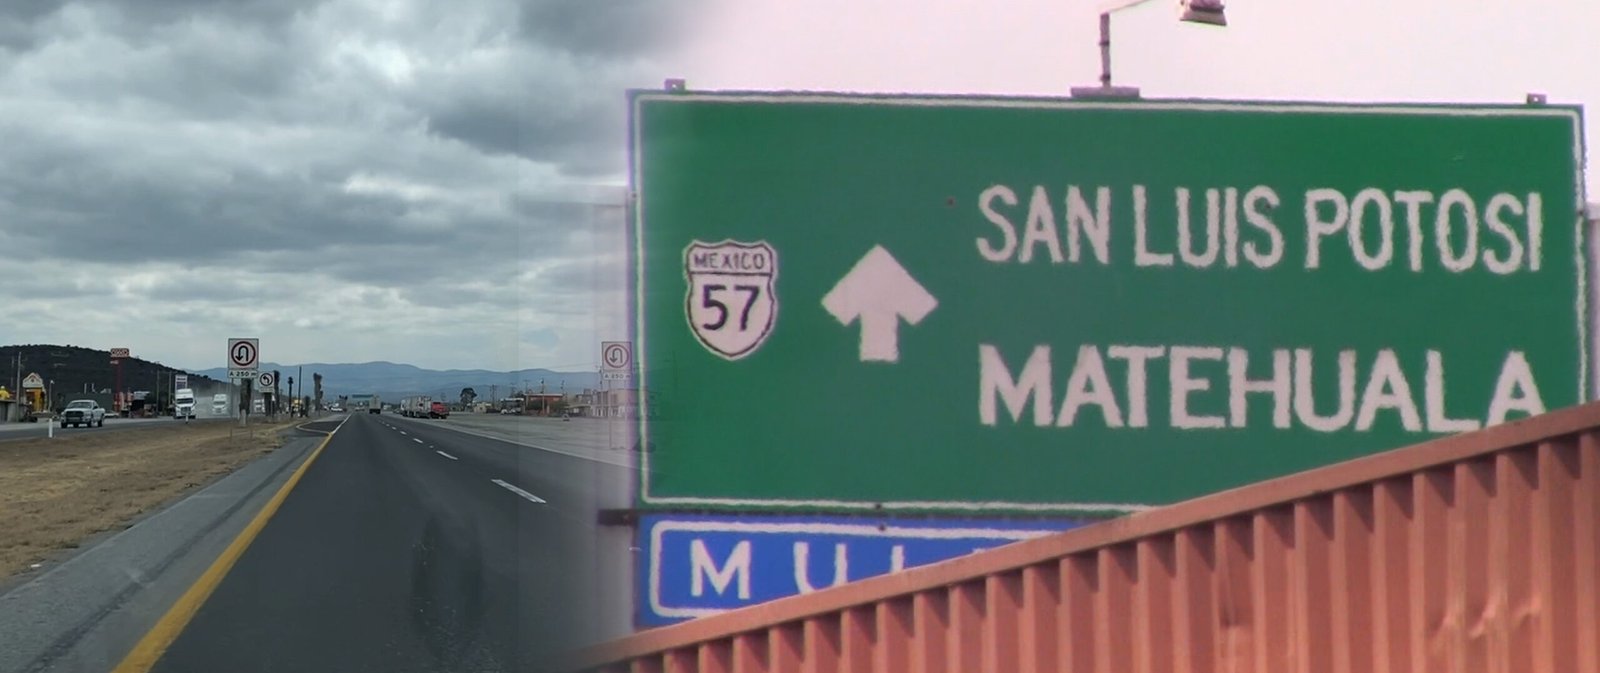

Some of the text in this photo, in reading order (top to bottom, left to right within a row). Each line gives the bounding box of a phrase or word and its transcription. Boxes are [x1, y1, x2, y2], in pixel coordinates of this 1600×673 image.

[693, 252, 765, 270] MEXICO
[976, 184, 1542, 275] SAN LUIS POTOSI
[702, 284, 760, 331] 57
[978, 343, 1547, 433] MATEHUALA
